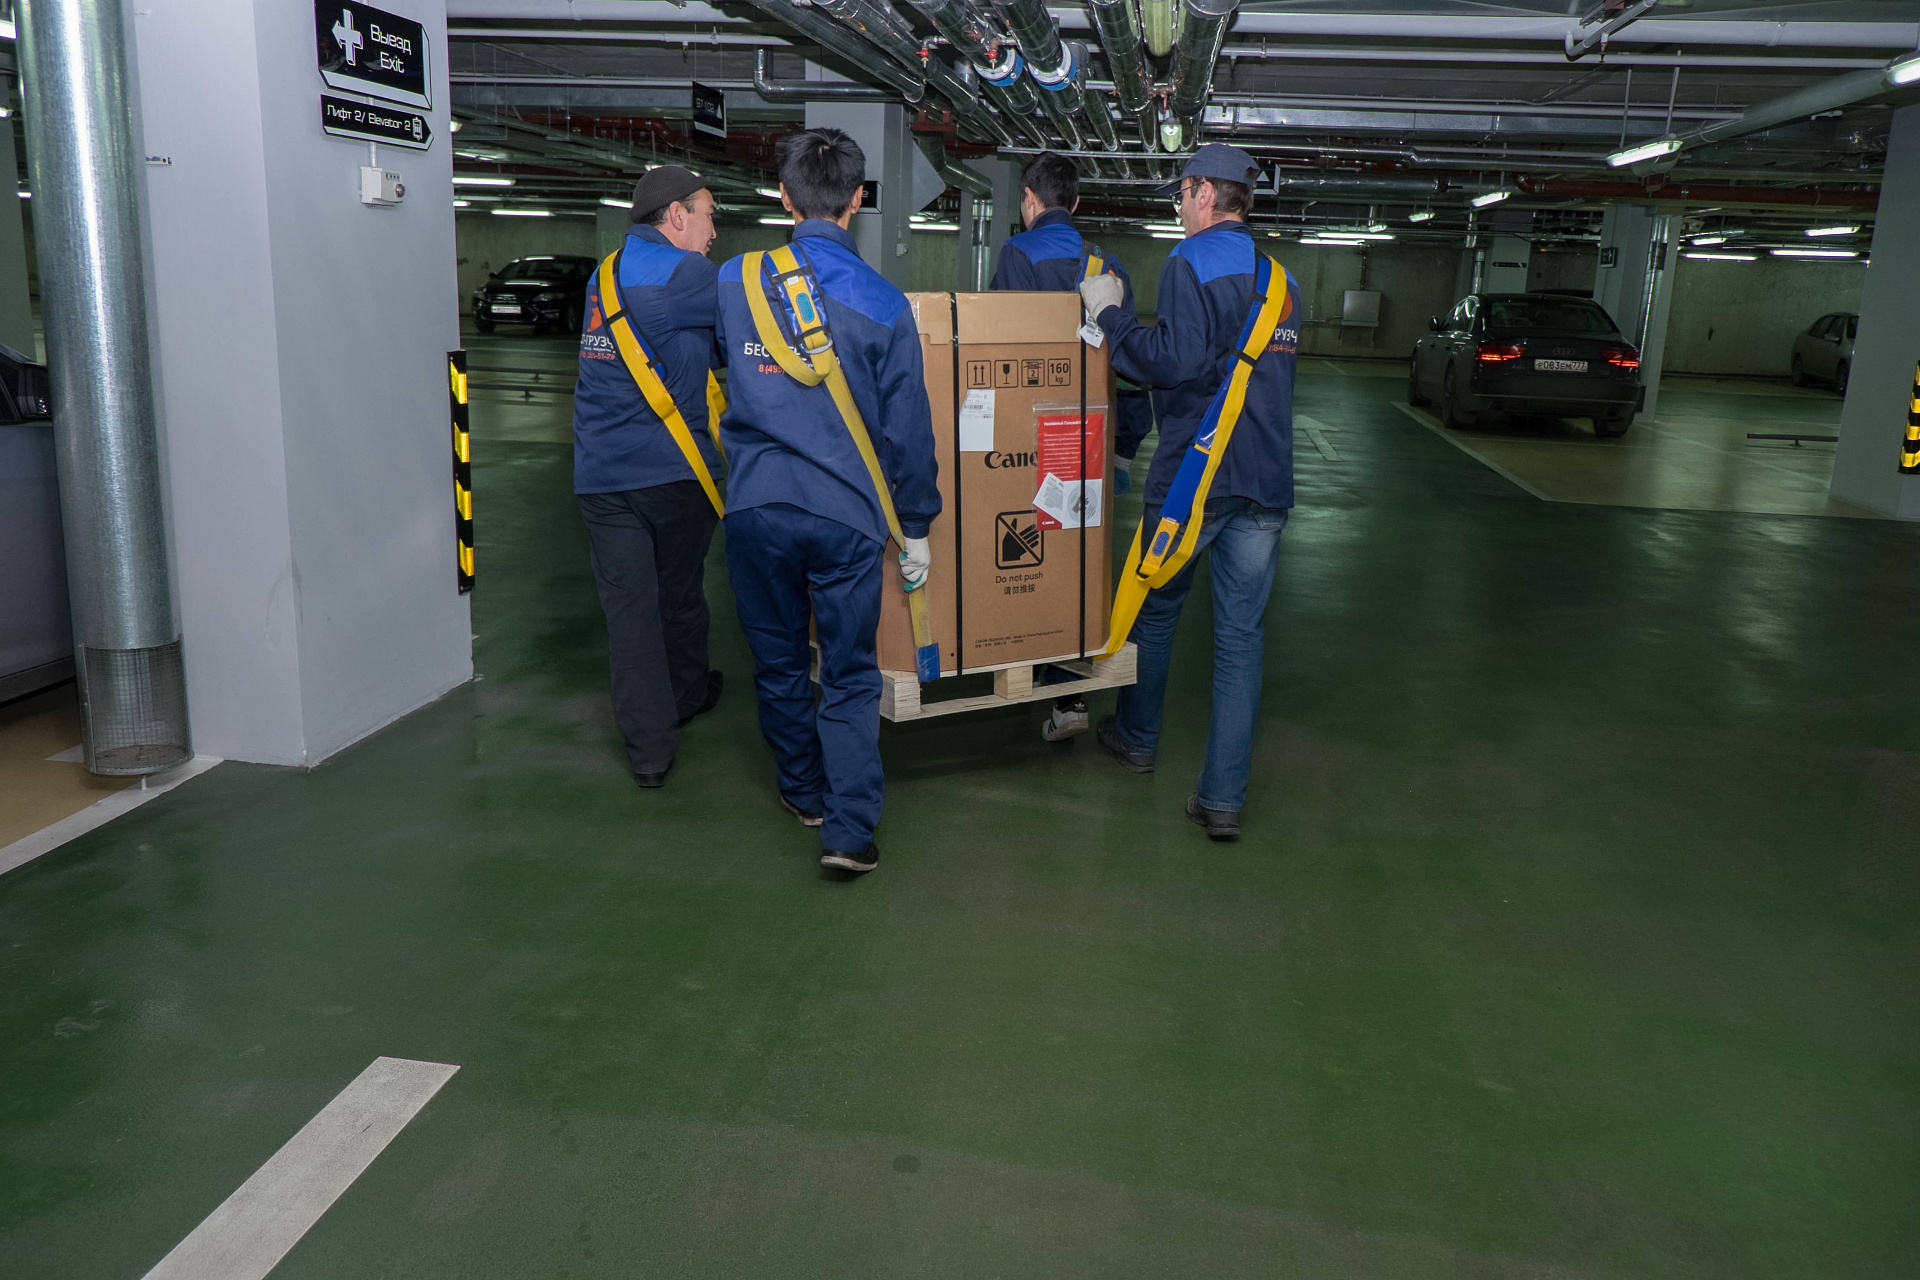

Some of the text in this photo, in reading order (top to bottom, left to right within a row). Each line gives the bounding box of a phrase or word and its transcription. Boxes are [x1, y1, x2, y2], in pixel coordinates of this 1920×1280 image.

[370, 23, 412, 56] Выезд
[379, 51, 405, 74] Exit
[327, 104, 352, 122] Лифт
[368, 113, 402, 129] Elevator
[404, 119, 411, 131] 2
[1275, 328, 1297, 343] РУЗЧ
[758, 363, 764, 373] 8
[1031, 369, 1036, 378] 2
[1049, 363, 1069, 374] 160
[1055, 375, 1064, 384] kg
[984, 450, 1038, 469] Can
[995, 571, 1044, 584] Do not push
[1003, 583, 1036, 596] 请勿推按
